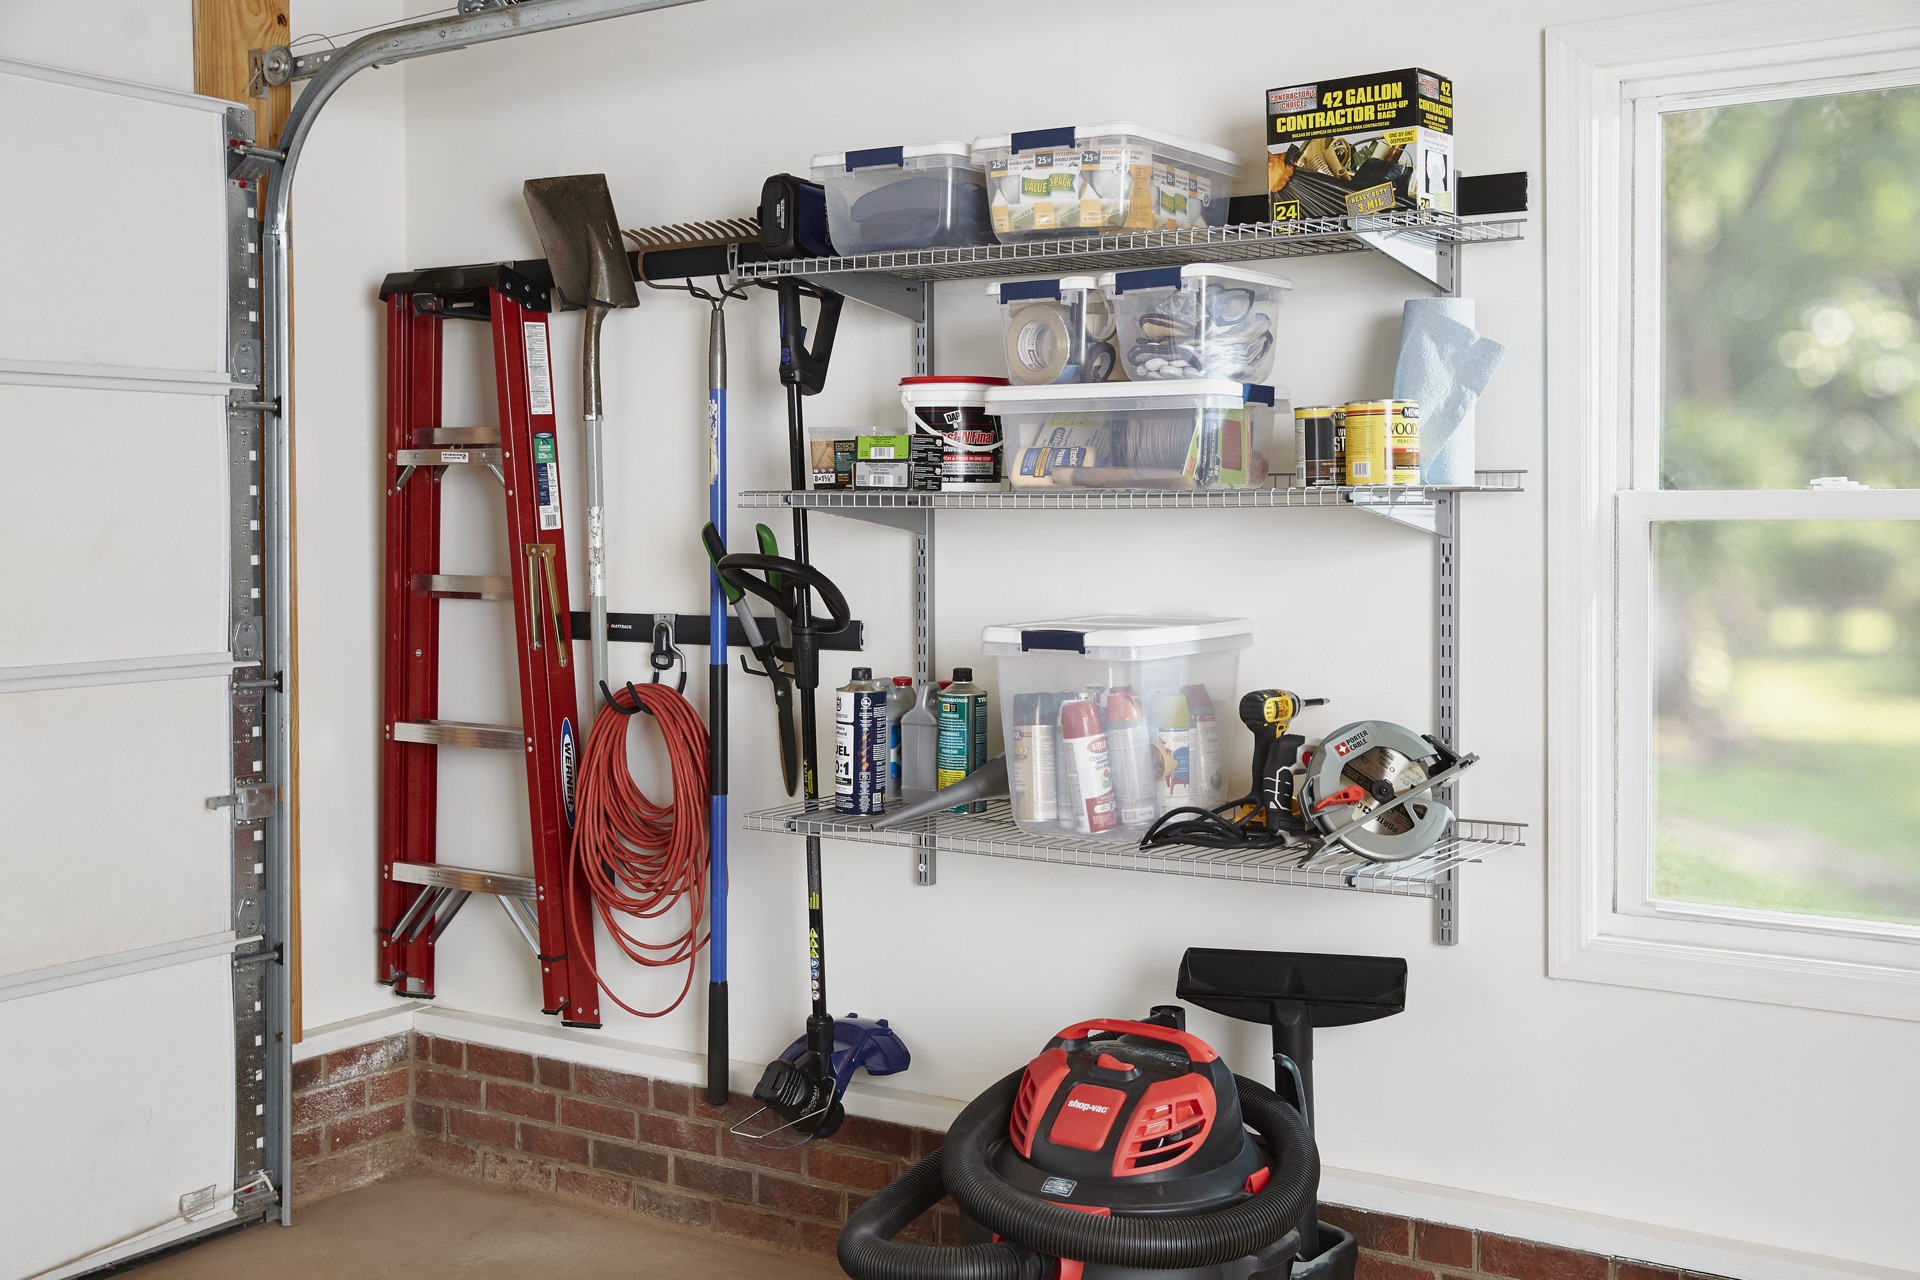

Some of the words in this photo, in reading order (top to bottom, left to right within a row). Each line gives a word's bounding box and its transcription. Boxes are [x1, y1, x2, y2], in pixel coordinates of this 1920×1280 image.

[1322, 91, 1343, 109] 42
[1345, 82, 1402, 105] GALLON
[1440, 81, 1451, 97] 42
[1281, 101, 1304, 111] CHOICE
[1377, 100, 1409, 111] CLEAN-UP
[1419, 98, 1453, 118] CONTRACTOR
[1276, 105, 1375, 133] CONTRACTOR
[1377, 110, 1396, 119] BAGS
[1024, 181, 1047, 193] VALUE
[1351, 194, 1370, 204] HEAVY
[1372, 188, 1388, 197] DUTY
[1357, 203, 1364, 213] 3
[1367, 198, 1385, 210] MIL
[1420, 199, 1429, 210] 24
[1276, 205, 1297, 220] 24
[946, 412, 960, 422] DAP
[972, 430, 995, 444] Final
[1345, 730, 1369, 745] PORTER
[1350, 738, 1368, 751] CABLE
[564, 742, 574, 806] WERNER
[1375, 815, 1399, 834] PORTE
